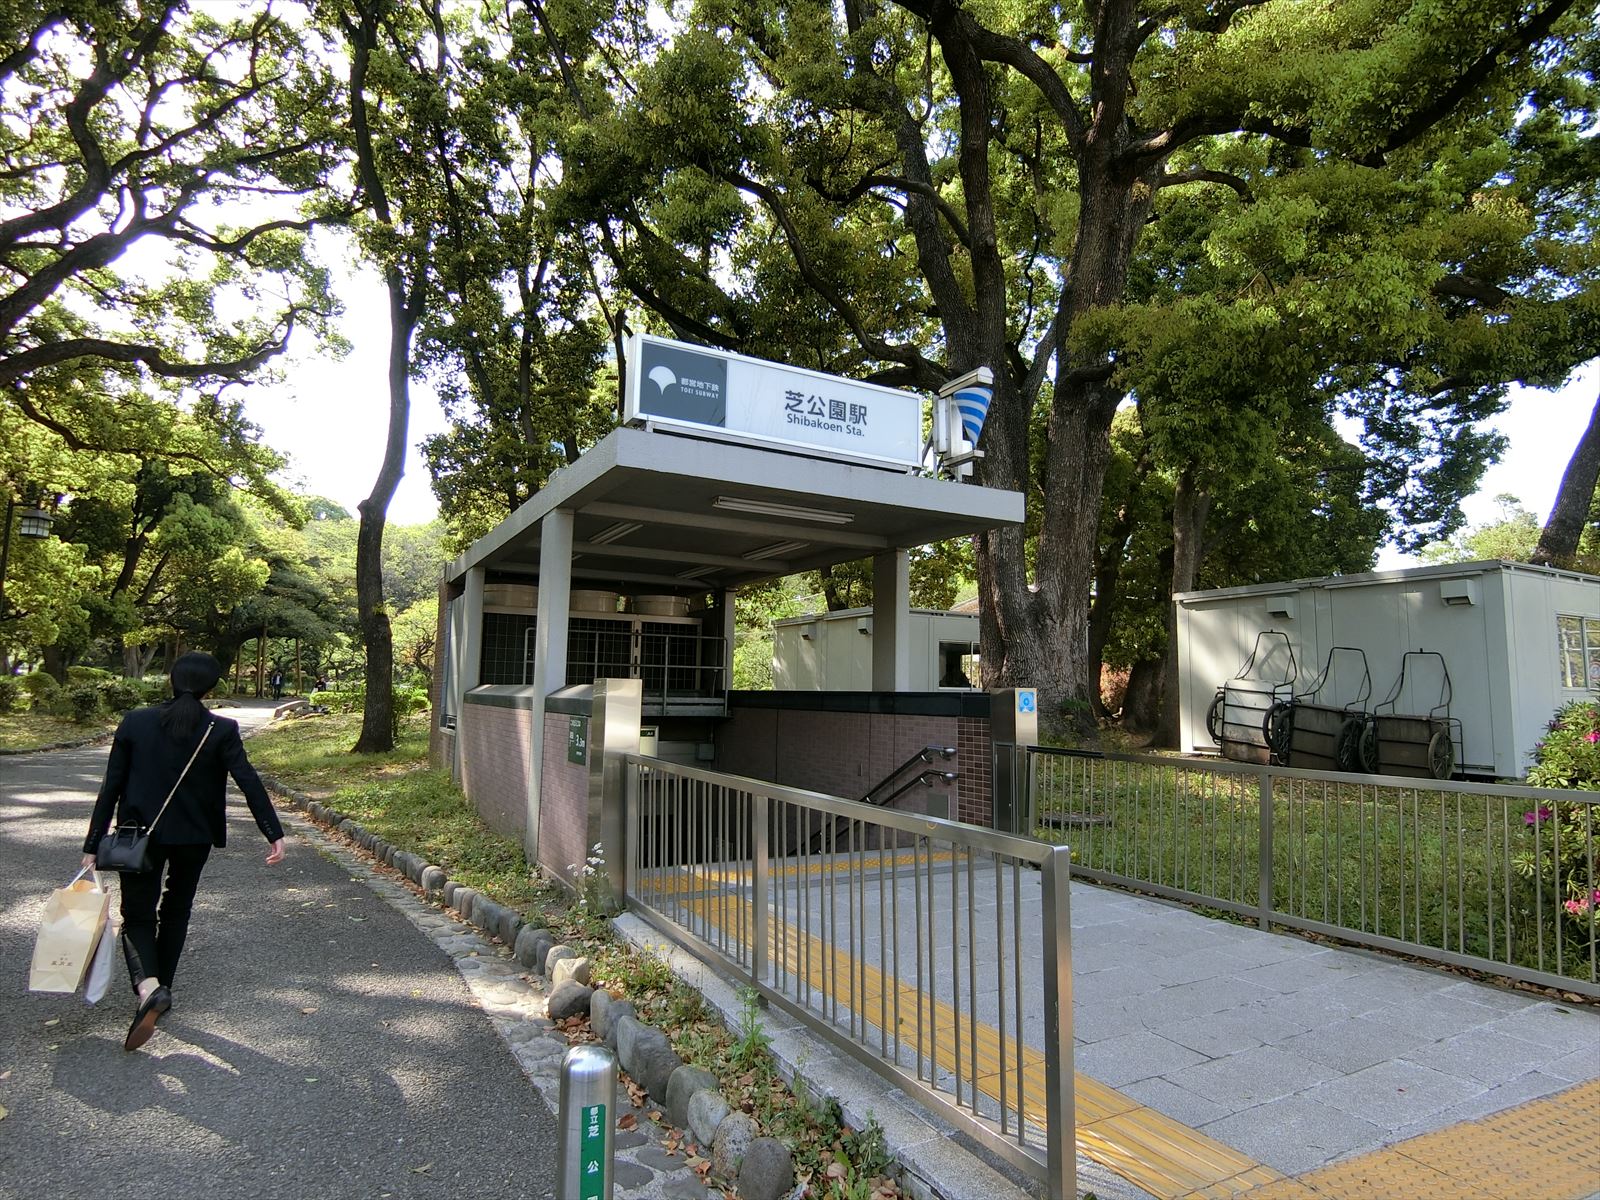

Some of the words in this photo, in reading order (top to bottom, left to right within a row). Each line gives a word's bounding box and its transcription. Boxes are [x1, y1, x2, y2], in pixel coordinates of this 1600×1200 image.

[680, 386, 694, 394] TOEI
[695, 389, 719, 399] SUBWAY
[681, 377, 719, 392] 都営地下鉄
[785, 390, 867, 426] 芝公園駅
[787, 413, 843, 433] Shibakoen
[846, 424, 865, 437] Sta.
